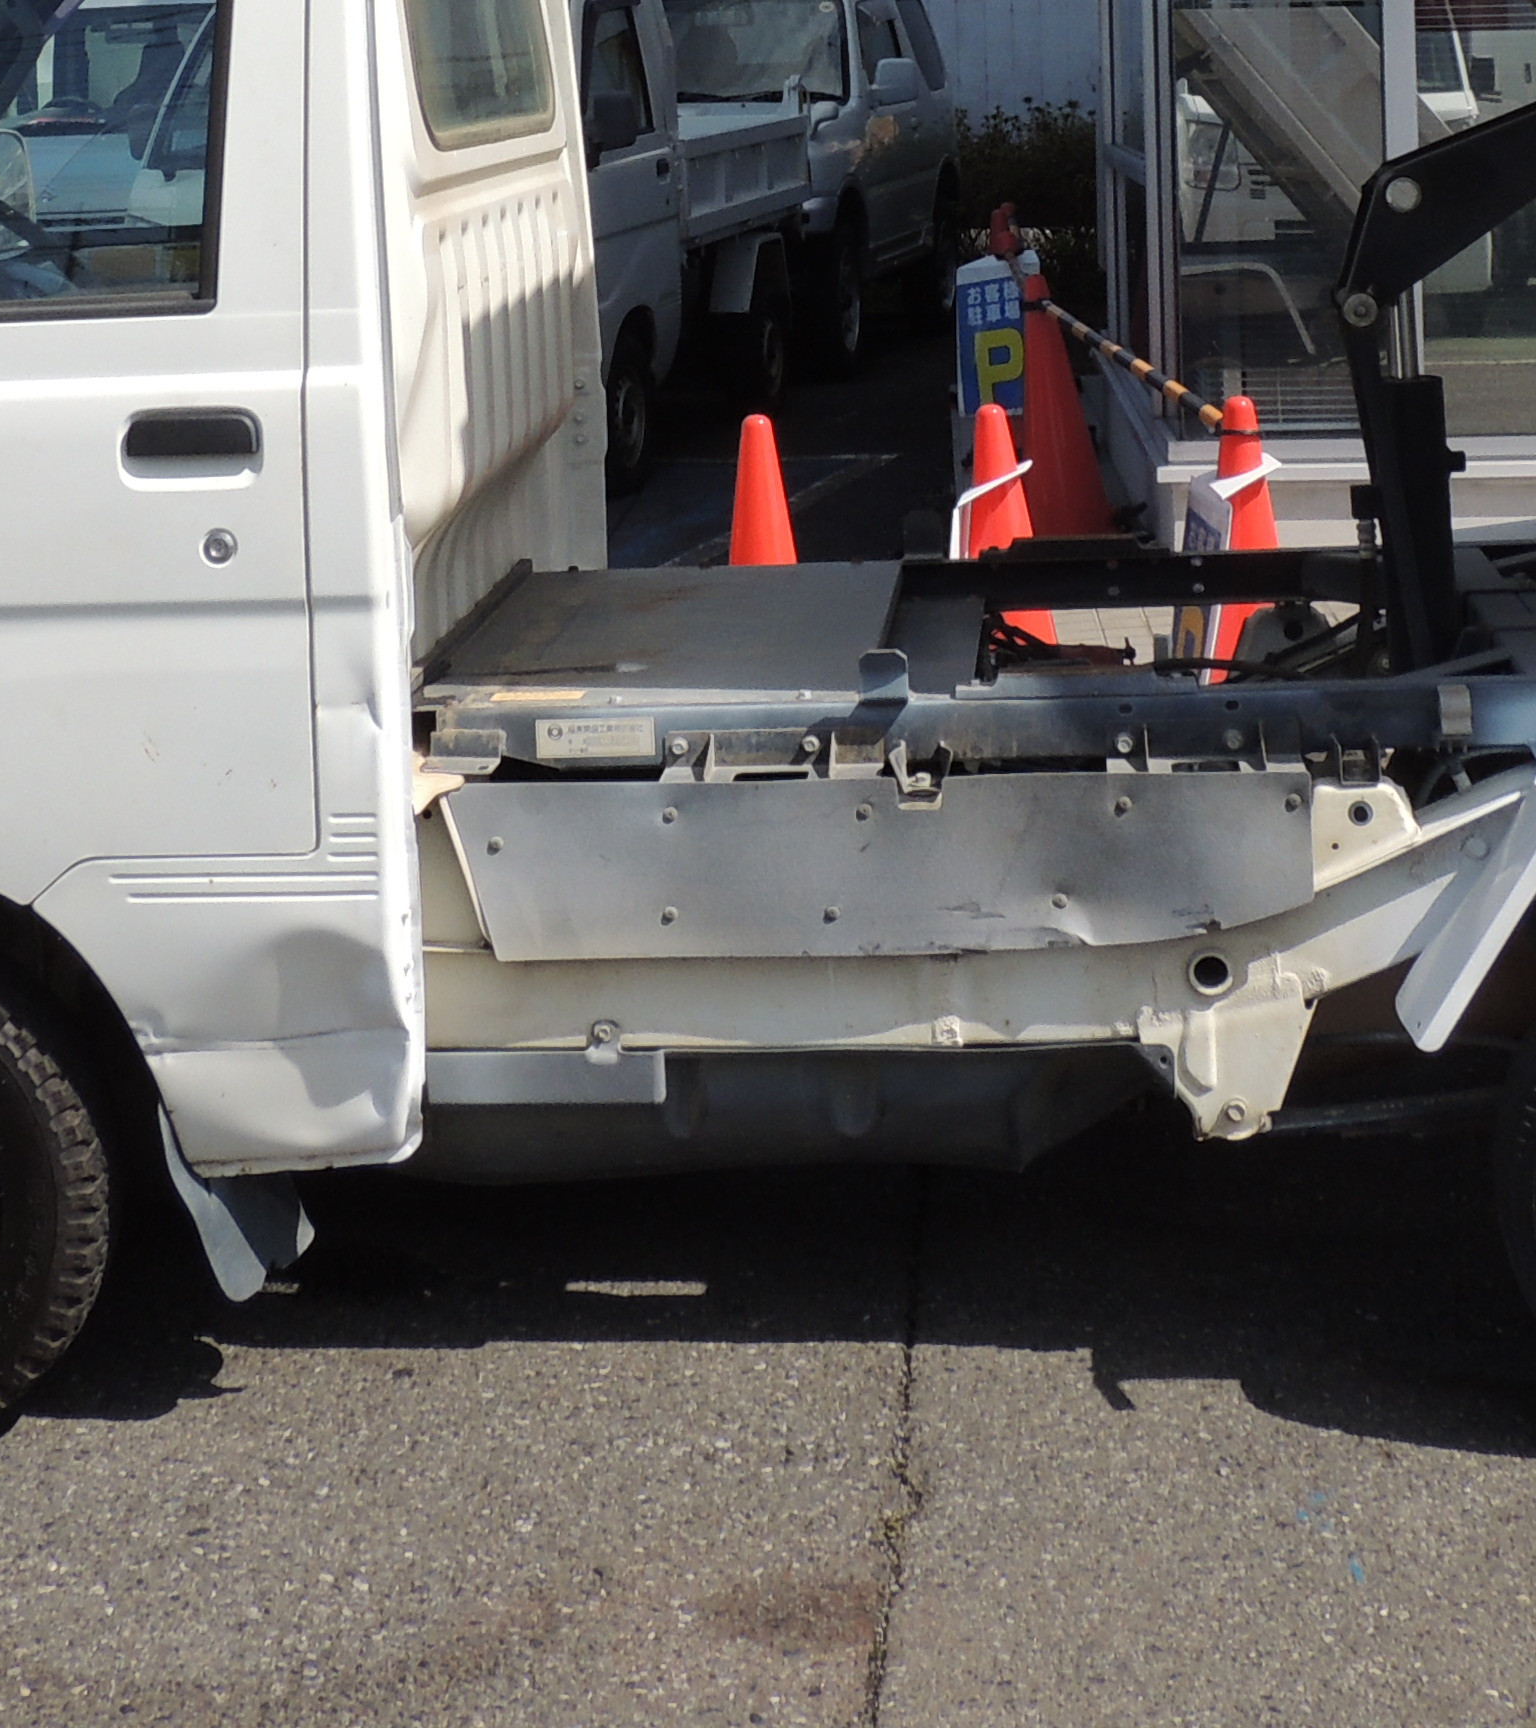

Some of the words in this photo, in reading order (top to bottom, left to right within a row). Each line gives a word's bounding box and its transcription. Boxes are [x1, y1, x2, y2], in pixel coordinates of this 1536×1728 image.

[967, 280, 1019, 305] お客様
[967, 300, 1020, 326] 駐車場
[974, 327, 1024, 406] P
